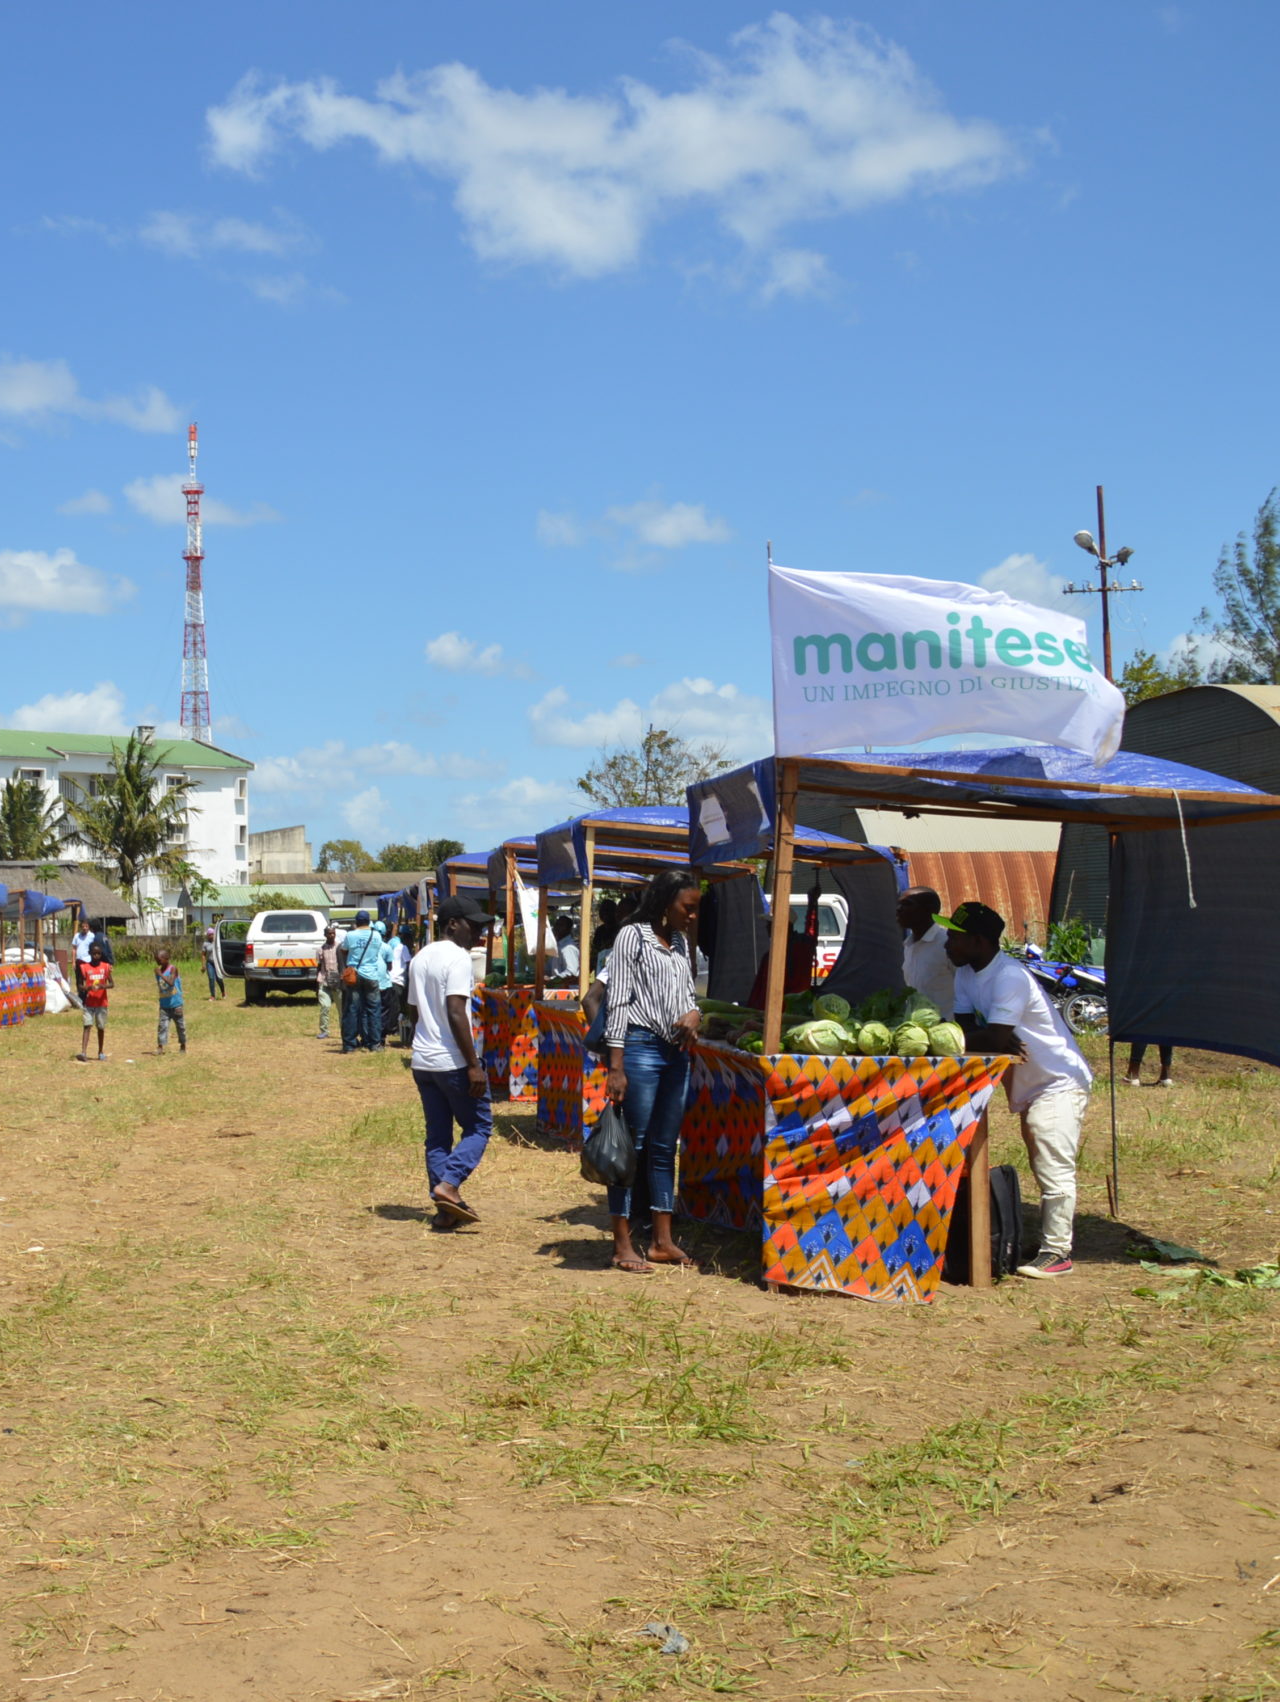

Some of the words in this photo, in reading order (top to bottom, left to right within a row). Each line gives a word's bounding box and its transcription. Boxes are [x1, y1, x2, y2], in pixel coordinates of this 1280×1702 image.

[793, 612, 1093, 676] manitese
[803, 686, 835, 703] UN
[844, 679, 951, 701] IMPEGNO
[960, 676, 983, 694] DI
